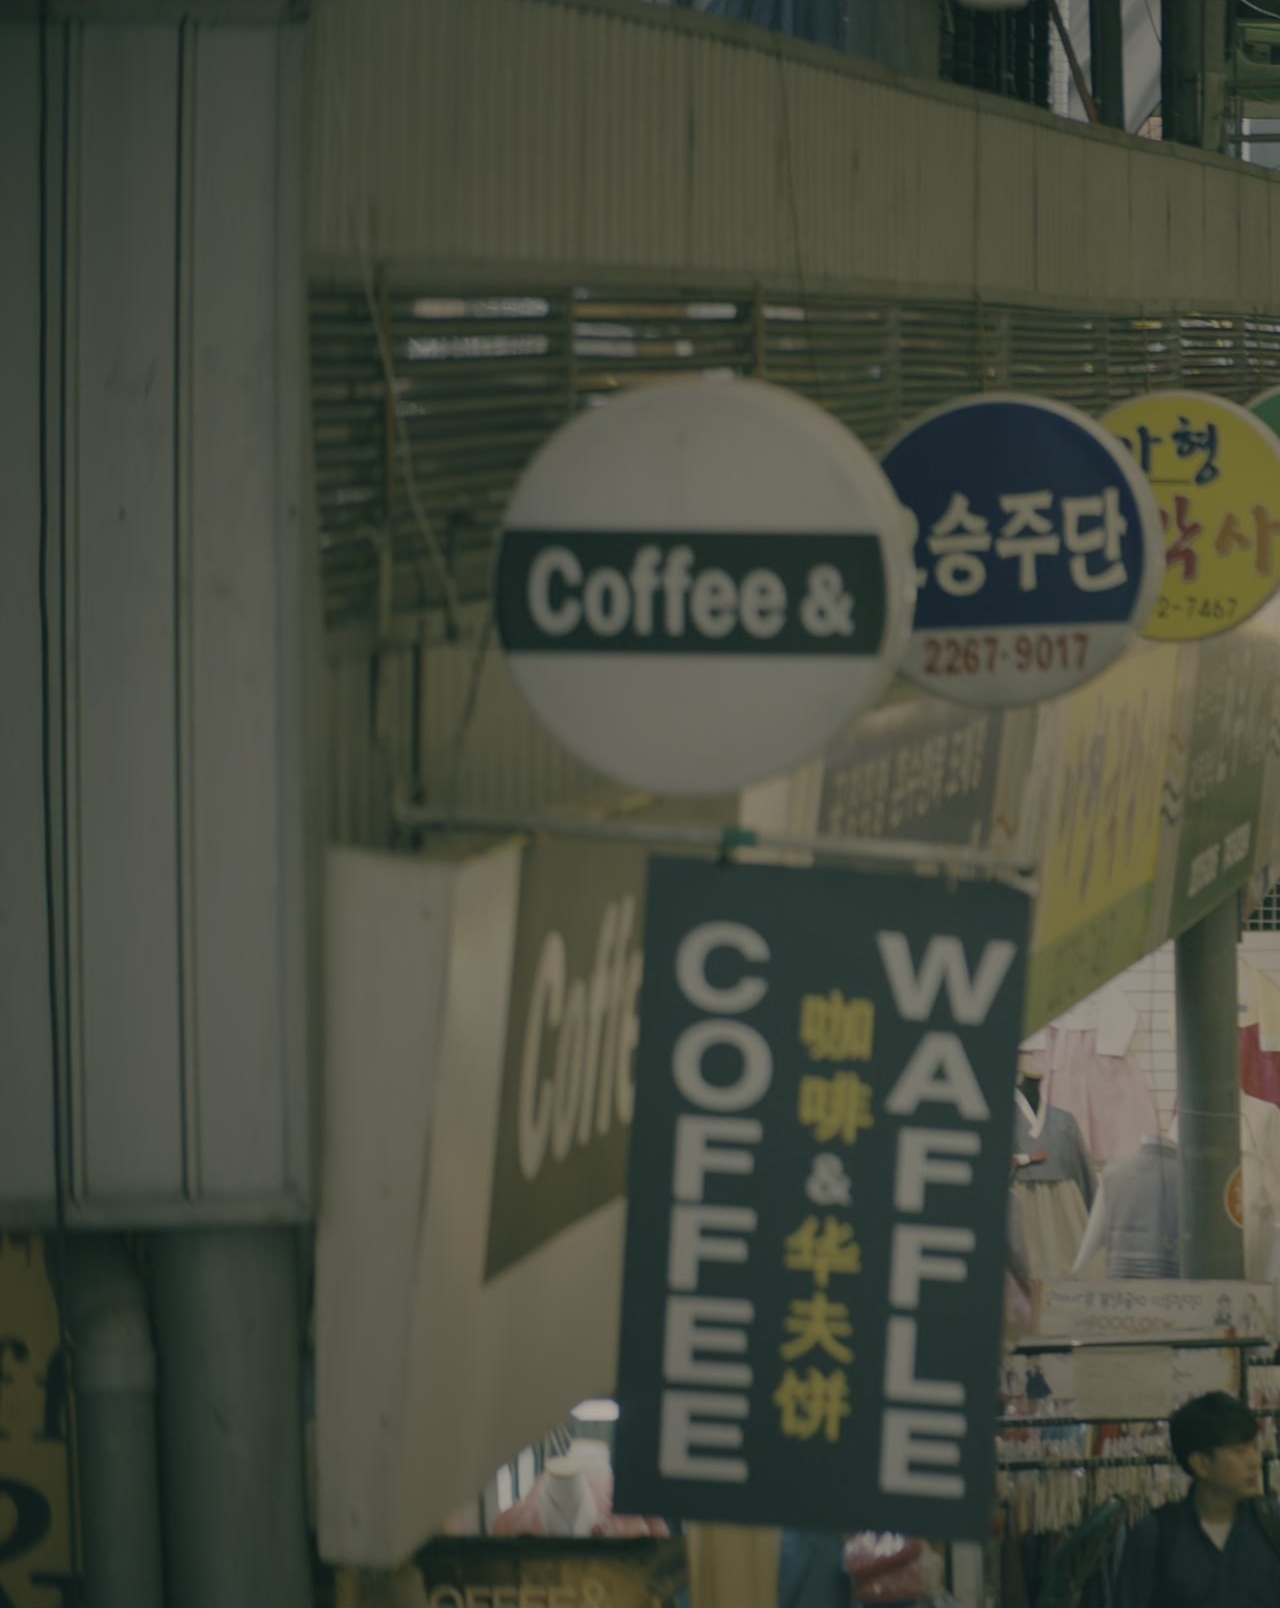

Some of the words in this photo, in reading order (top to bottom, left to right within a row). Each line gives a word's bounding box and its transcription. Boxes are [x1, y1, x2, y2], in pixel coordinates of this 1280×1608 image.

[527, 545, 787, 638] Coffee
[803, 563, 854, 638] &
[656, 921, 774, 1485] COFFEE
[876, 929, 1016, 1500] WAFFLE
